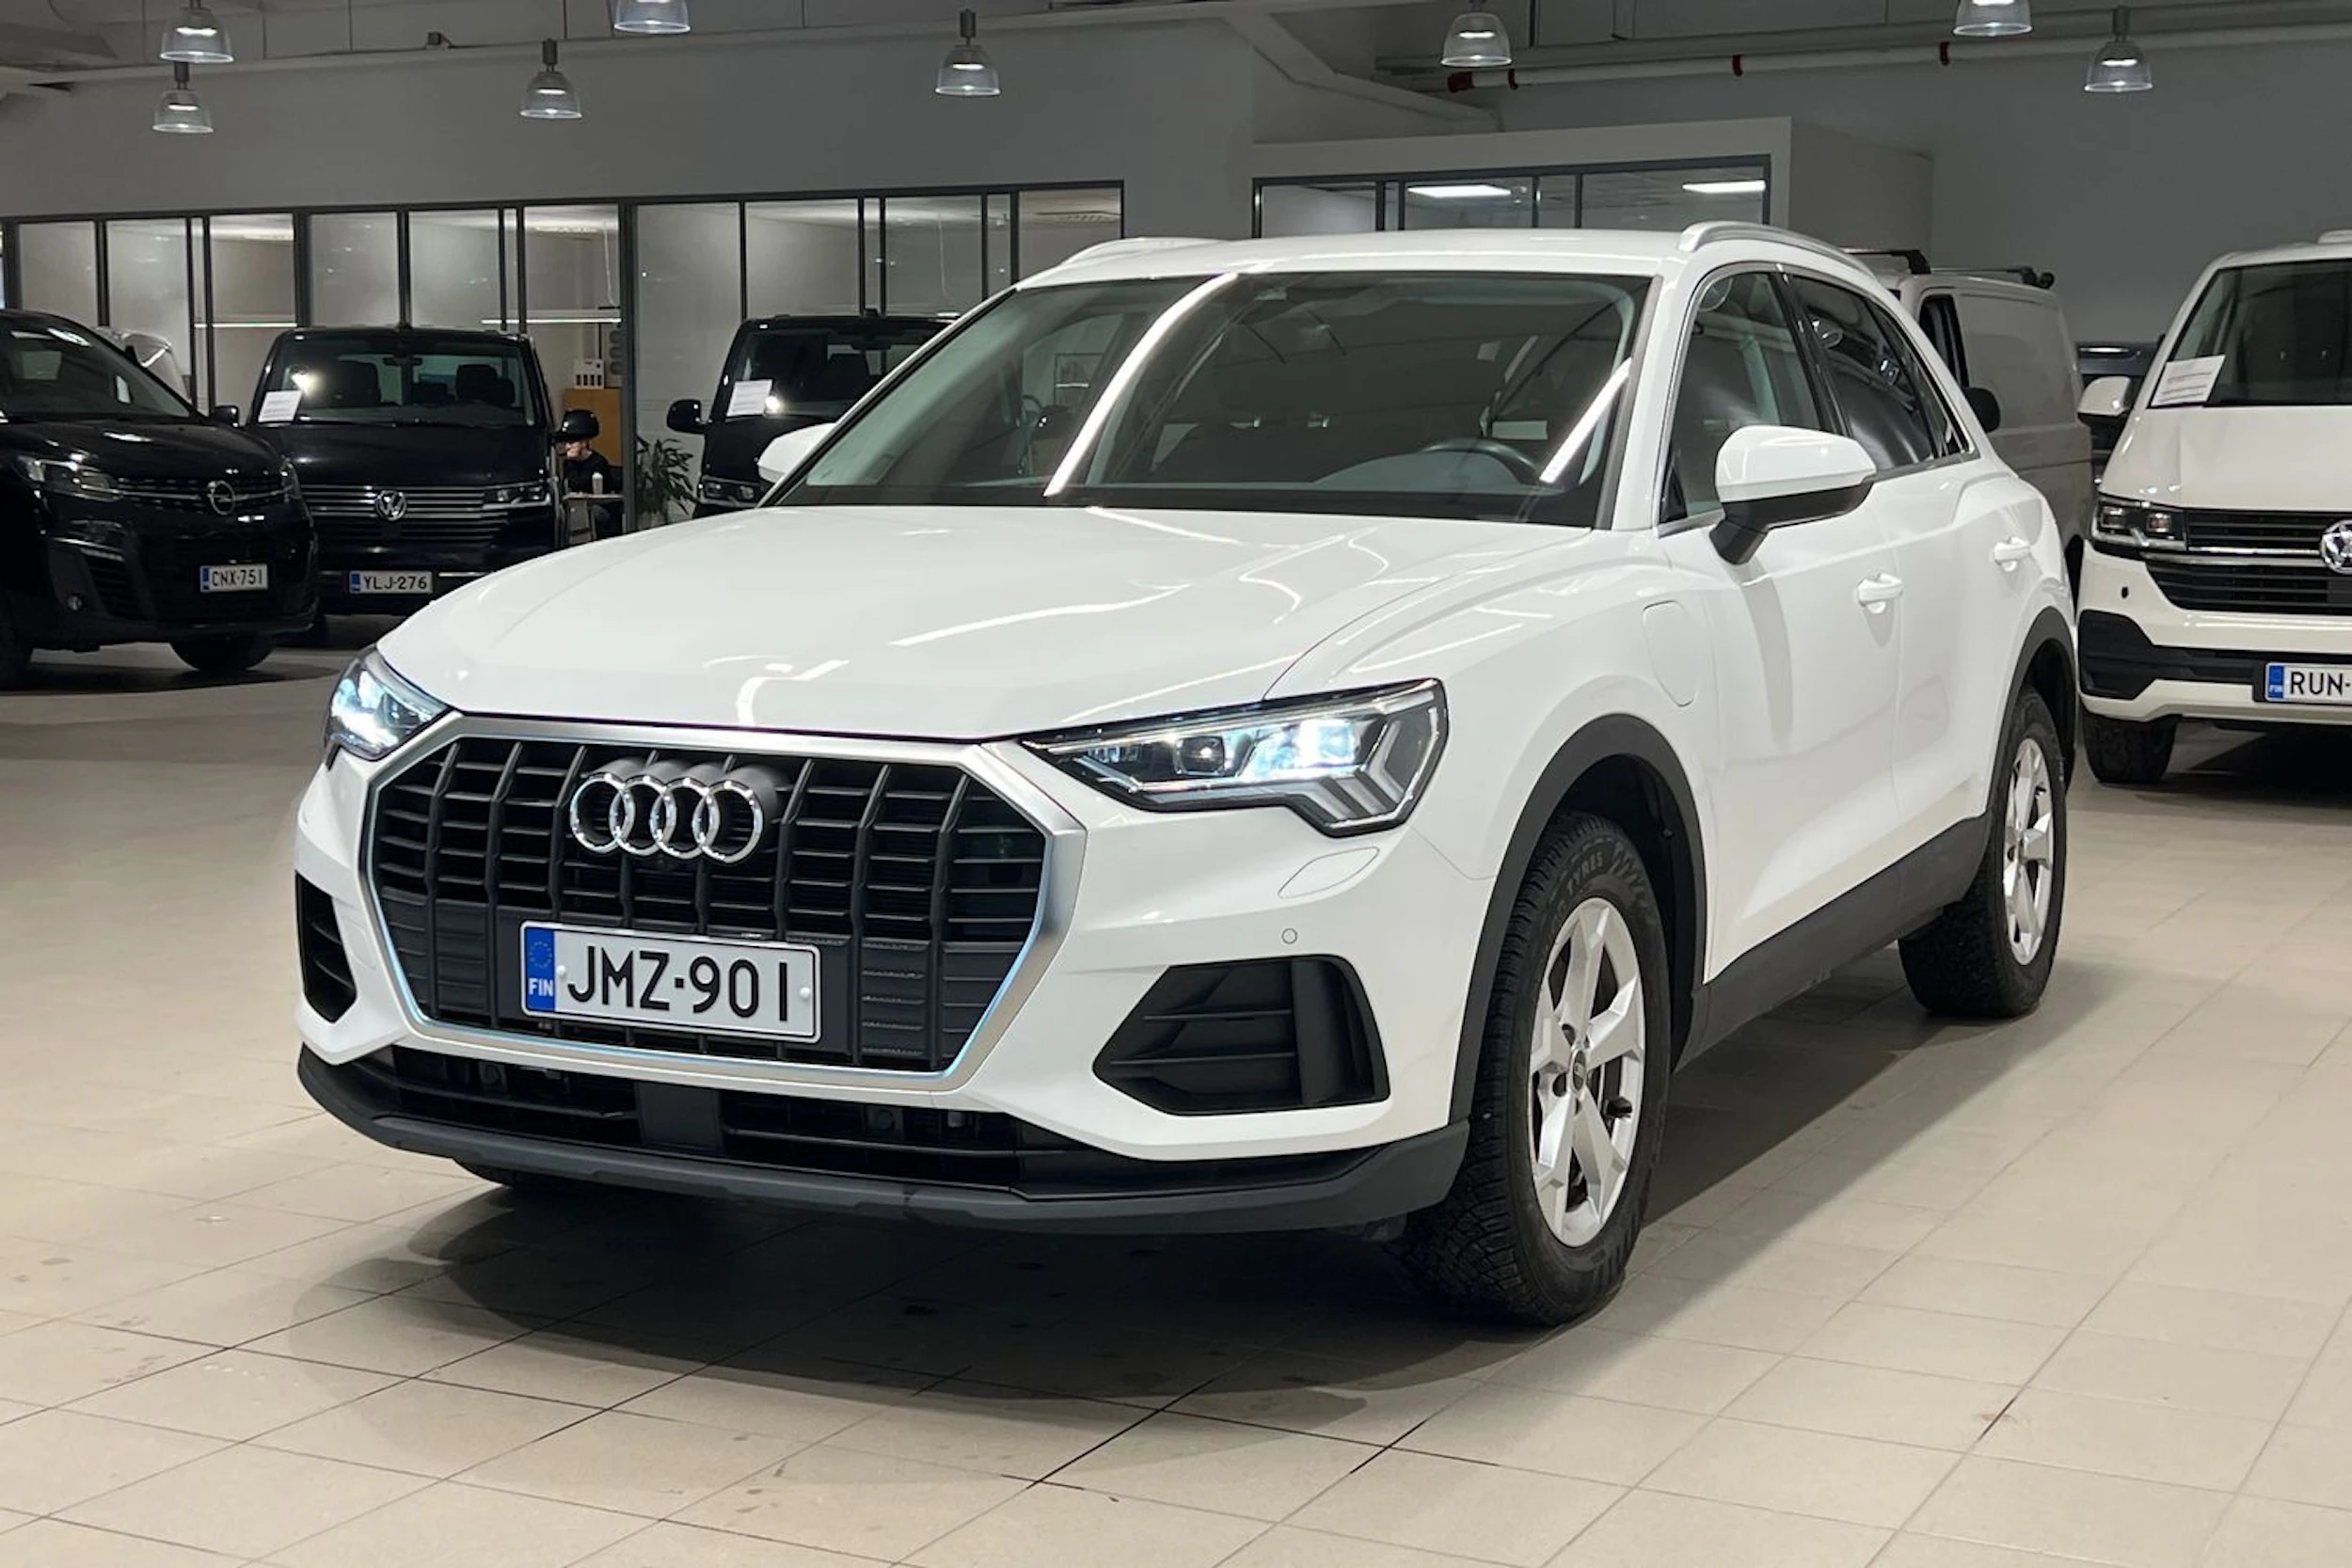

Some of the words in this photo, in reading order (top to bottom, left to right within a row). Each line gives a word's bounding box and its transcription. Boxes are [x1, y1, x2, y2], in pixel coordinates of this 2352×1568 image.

[212, 568, 262, 587] CNX-751
[363, 576, 427, 590] YLJ-276
[528, 977, 554, 998] FIN
[567, 945, 787, 1022] JMZ-901
